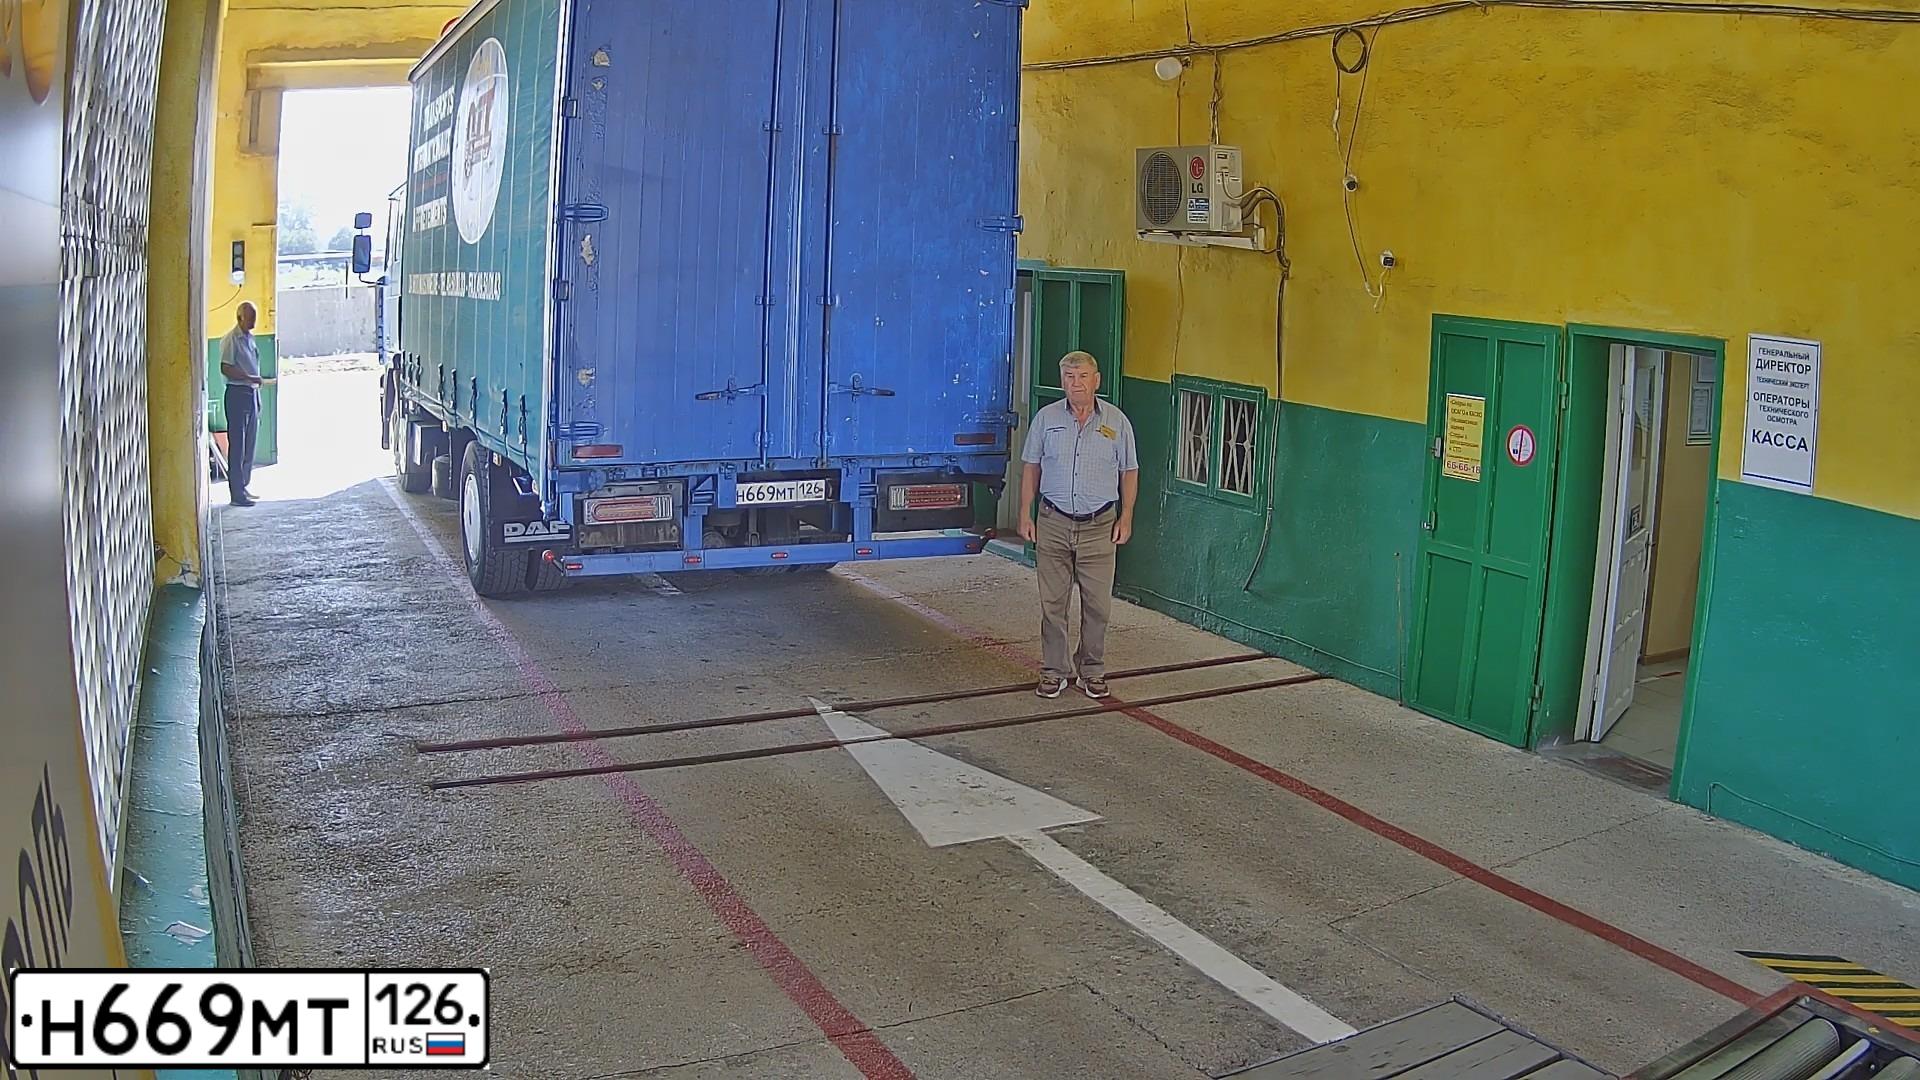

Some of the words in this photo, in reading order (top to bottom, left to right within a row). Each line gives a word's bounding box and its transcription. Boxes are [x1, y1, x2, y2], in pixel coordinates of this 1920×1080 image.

[1191, 182, 1204, 193] LG
[1758, 347, 1810, 360] ГЕНЕРАЛЬНЫЙ
[1755, 358, 1811, 375] ДИРЕКТОР
[1756, 376, 1788, 387] ТЕХНИЧЕСКИЙ
[1753, 391, 1810, 409] ОПЕРАТОРЫ
[1759, 404, 1809, 418] ТЕХНИЧЕСКОГО
[1766, 415, 1797, 426] ОСМОТРА
[1751, 428, 1808, 452] КАССА
[736, 485, 795, 502] Н669МТ
[799, 482, 820, 495] 126
[503, 520, 571, 537] DAF
